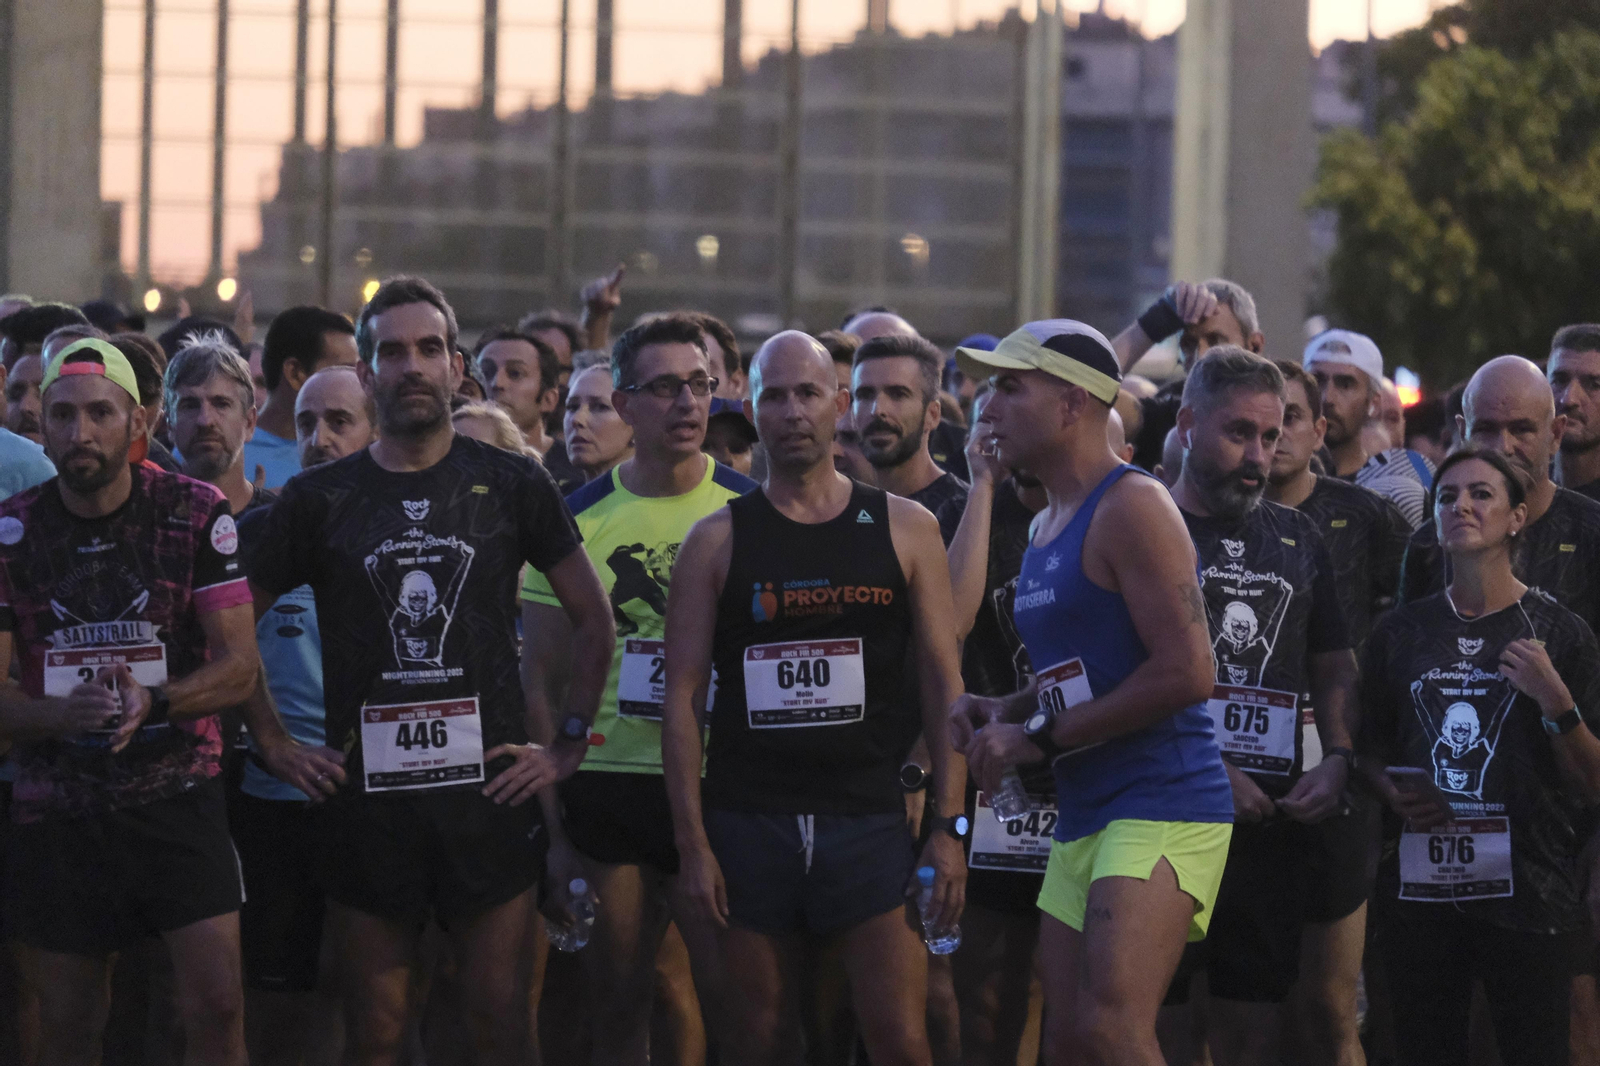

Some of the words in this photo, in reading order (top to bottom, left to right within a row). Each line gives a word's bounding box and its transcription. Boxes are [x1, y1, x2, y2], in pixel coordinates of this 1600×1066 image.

[402, 498, 431, 512] Rock
[403, 527, 424, 538] the
[375, 538, 422, 555] Running
[422, 534, 459, 549] Stones
[1225, 539, 1245, 550] Rock
[1224, 562, 1244, 572] the
[1202, 566, 1244, 588] Running
[1243, 570, 1279, 584] Stones
[783, 585, 893, 608] PROYECTO
[784, 604, 843, 618] HOMBRE
[405, 639, 428, 650] Rock
[1458, 637, 1485, 648] Rock
[781, 650, 798, 658] ROCK
[1451, 660, 1473, 670] the
[777, 658, 830, 690] 640
[1227, 666, 1248, 677] Rock
[1421, 668, 1470, 687] Running
[1224, 703, 1269, 735] 675
[396, 719, 448, 751] 446
[1447, 771, 1469, 781] Rock
[1450, 802, 1485, 811] UNNING
[1485, 803, 1505, 811] 2022
[1428, 836, 1475, 864] 676
